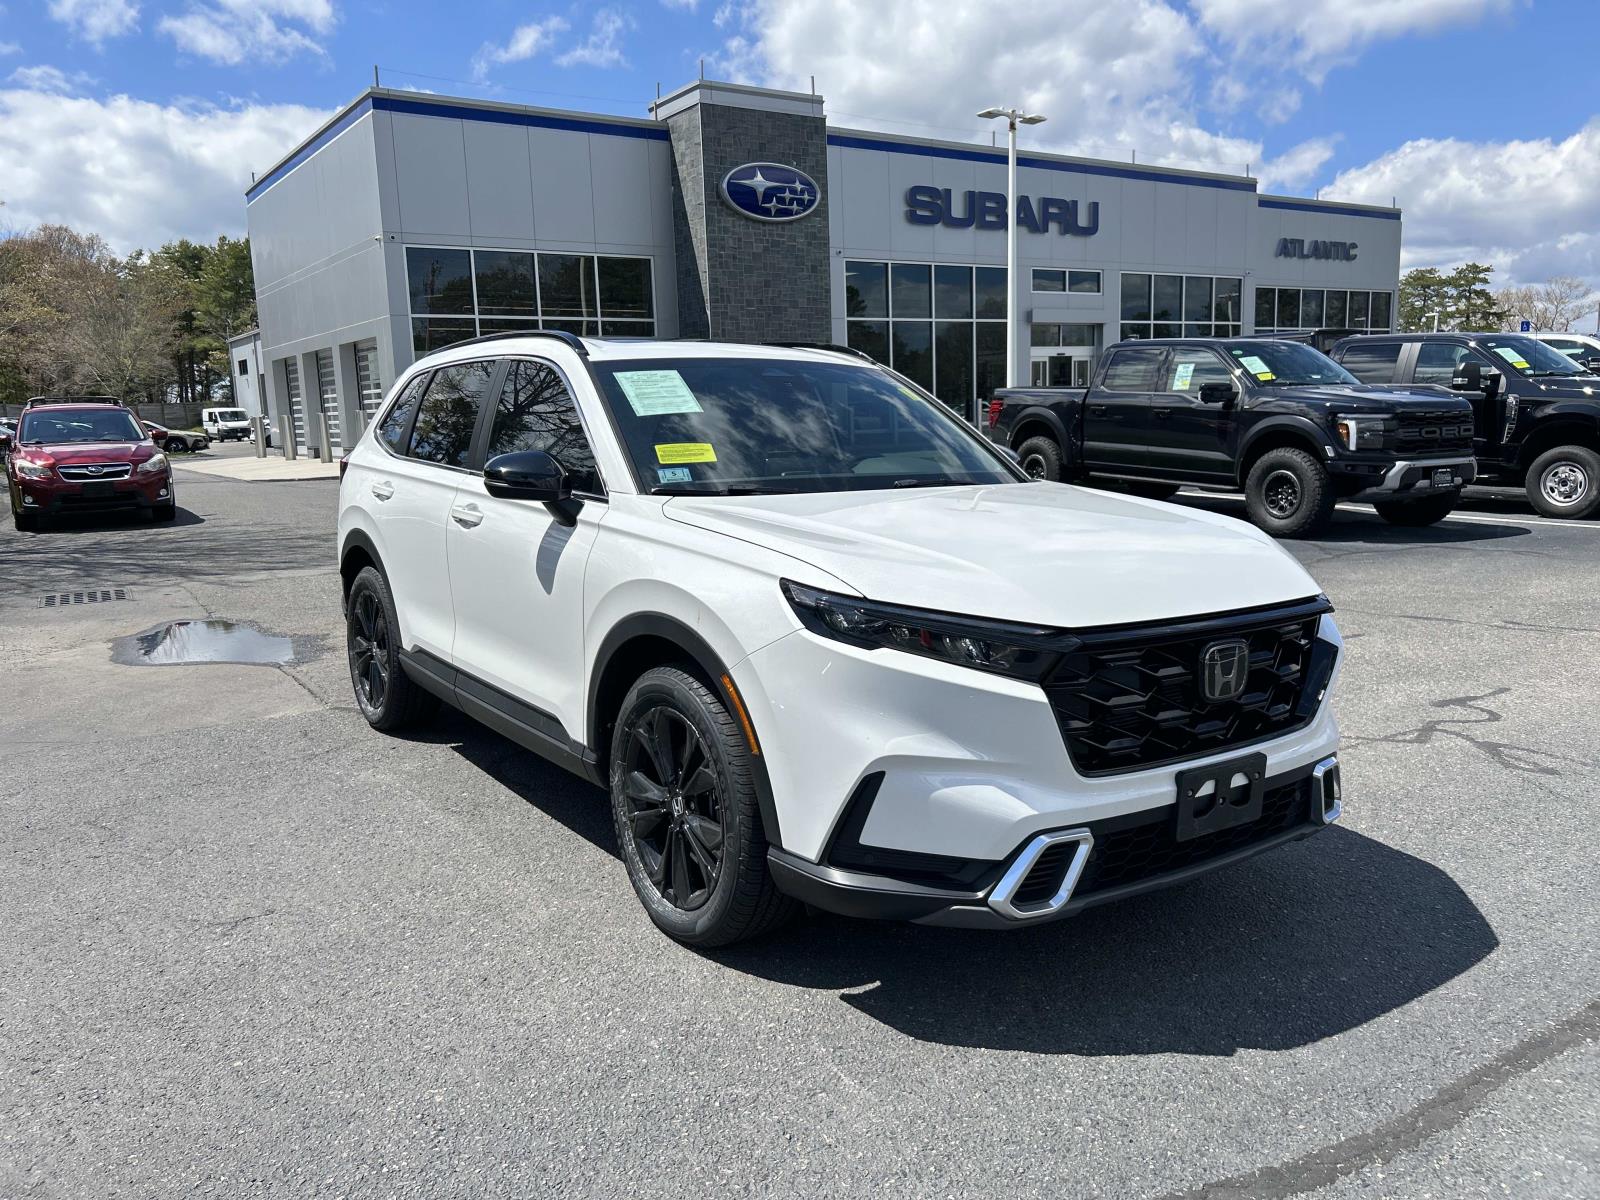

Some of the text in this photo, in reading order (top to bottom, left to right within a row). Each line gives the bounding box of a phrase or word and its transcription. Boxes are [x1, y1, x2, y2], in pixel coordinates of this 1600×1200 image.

[905, 185, 1099, 236] SUBARU
[1275, 237, 1358, 261] ATLANTIC
[1398, 425, 1474, 439] FORD
